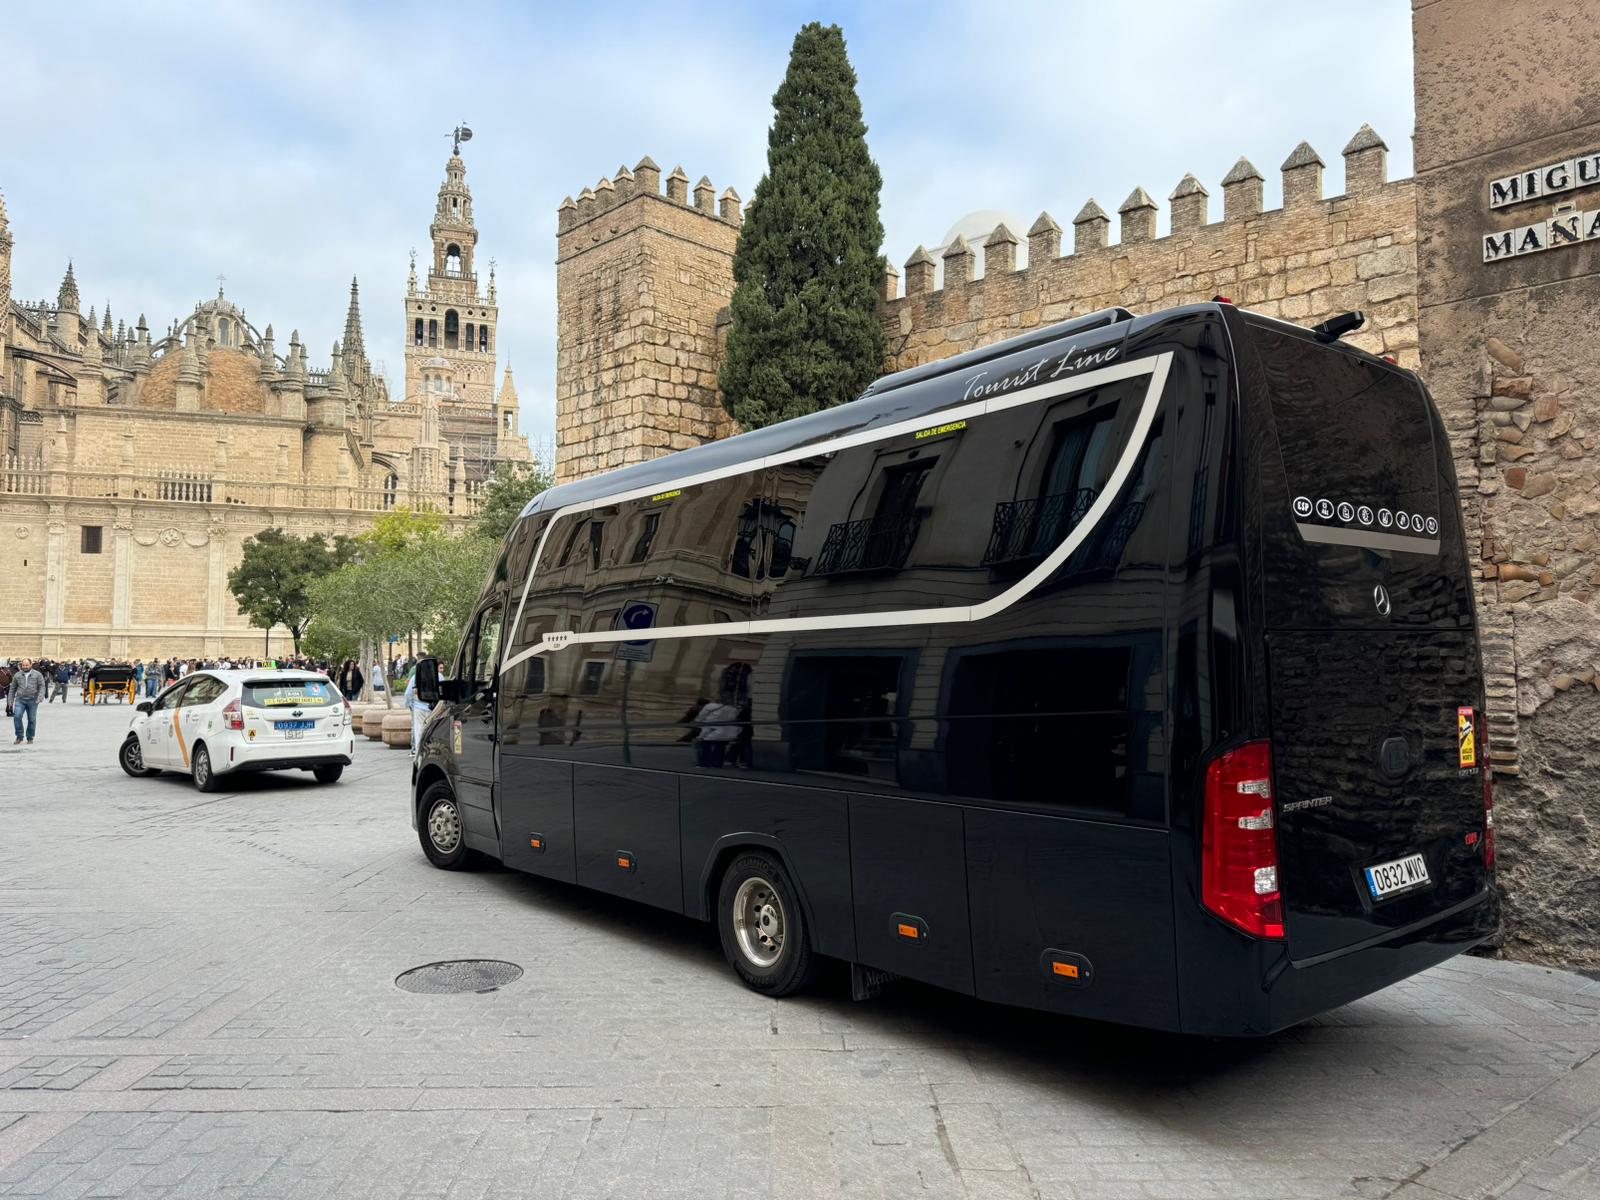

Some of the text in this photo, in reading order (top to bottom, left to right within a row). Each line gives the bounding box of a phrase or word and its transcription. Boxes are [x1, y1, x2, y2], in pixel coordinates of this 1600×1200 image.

[963, 345, 1120, 401] Tourist Line
[1297, 501, 1310, 512] ESP
[1283, 796, 1333, 813] SPRINTER
[1374, 863, 1407, 891] 0832
